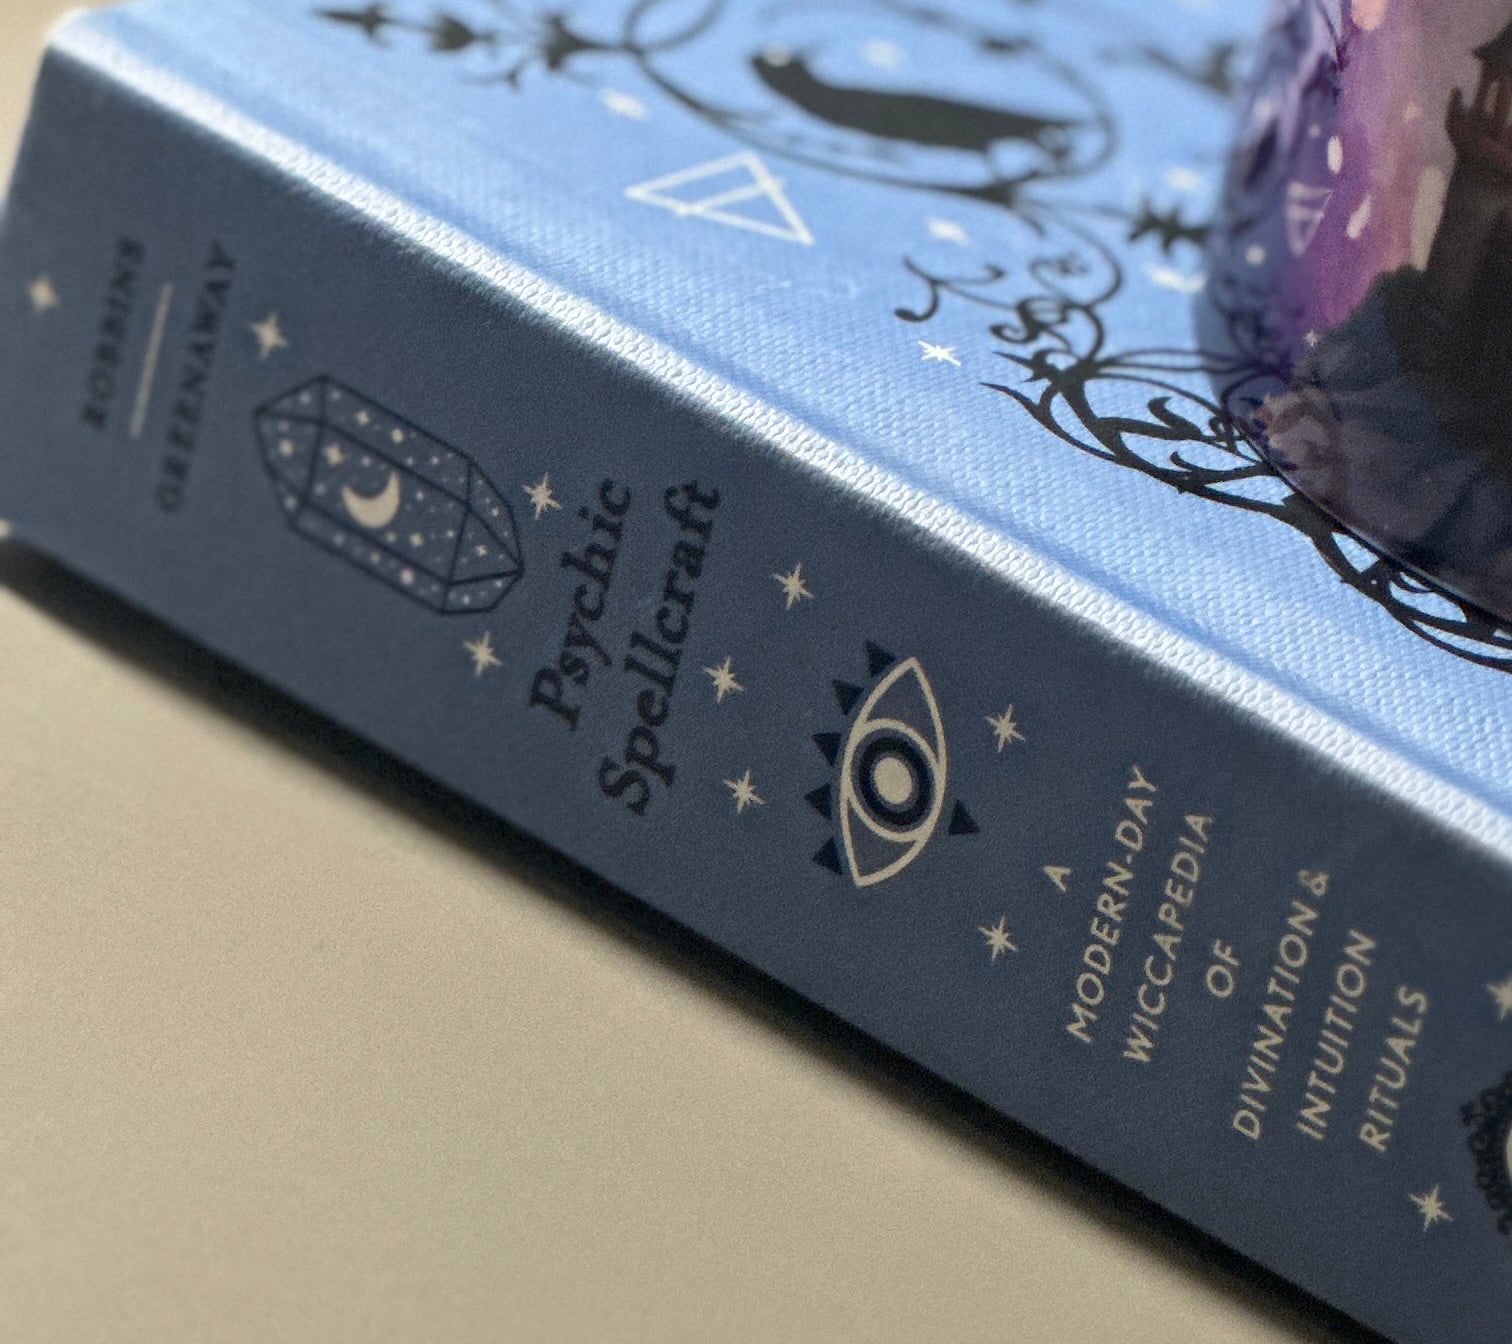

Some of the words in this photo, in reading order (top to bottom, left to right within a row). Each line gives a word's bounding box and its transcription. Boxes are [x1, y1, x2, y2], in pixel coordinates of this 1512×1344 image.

[528, 477, 634, 732] Psychic
[596, 478, 722, 817] Spellcraft
[1043, 863, 1072, 893] A
[1066, 764, 1159, 1045] MODERN-DAY
[1123, 813, 1214, 1064] WICCAPEDIA
[1206, 939, 1240, 999] OF
[1232, 900, 1319, 1141] DIVINATION
[1299, 868, 1331, 897] &
[1296, 928, 1377, 1141] INTUITION
[1359, 985, 1429, 1153] RITUALS
